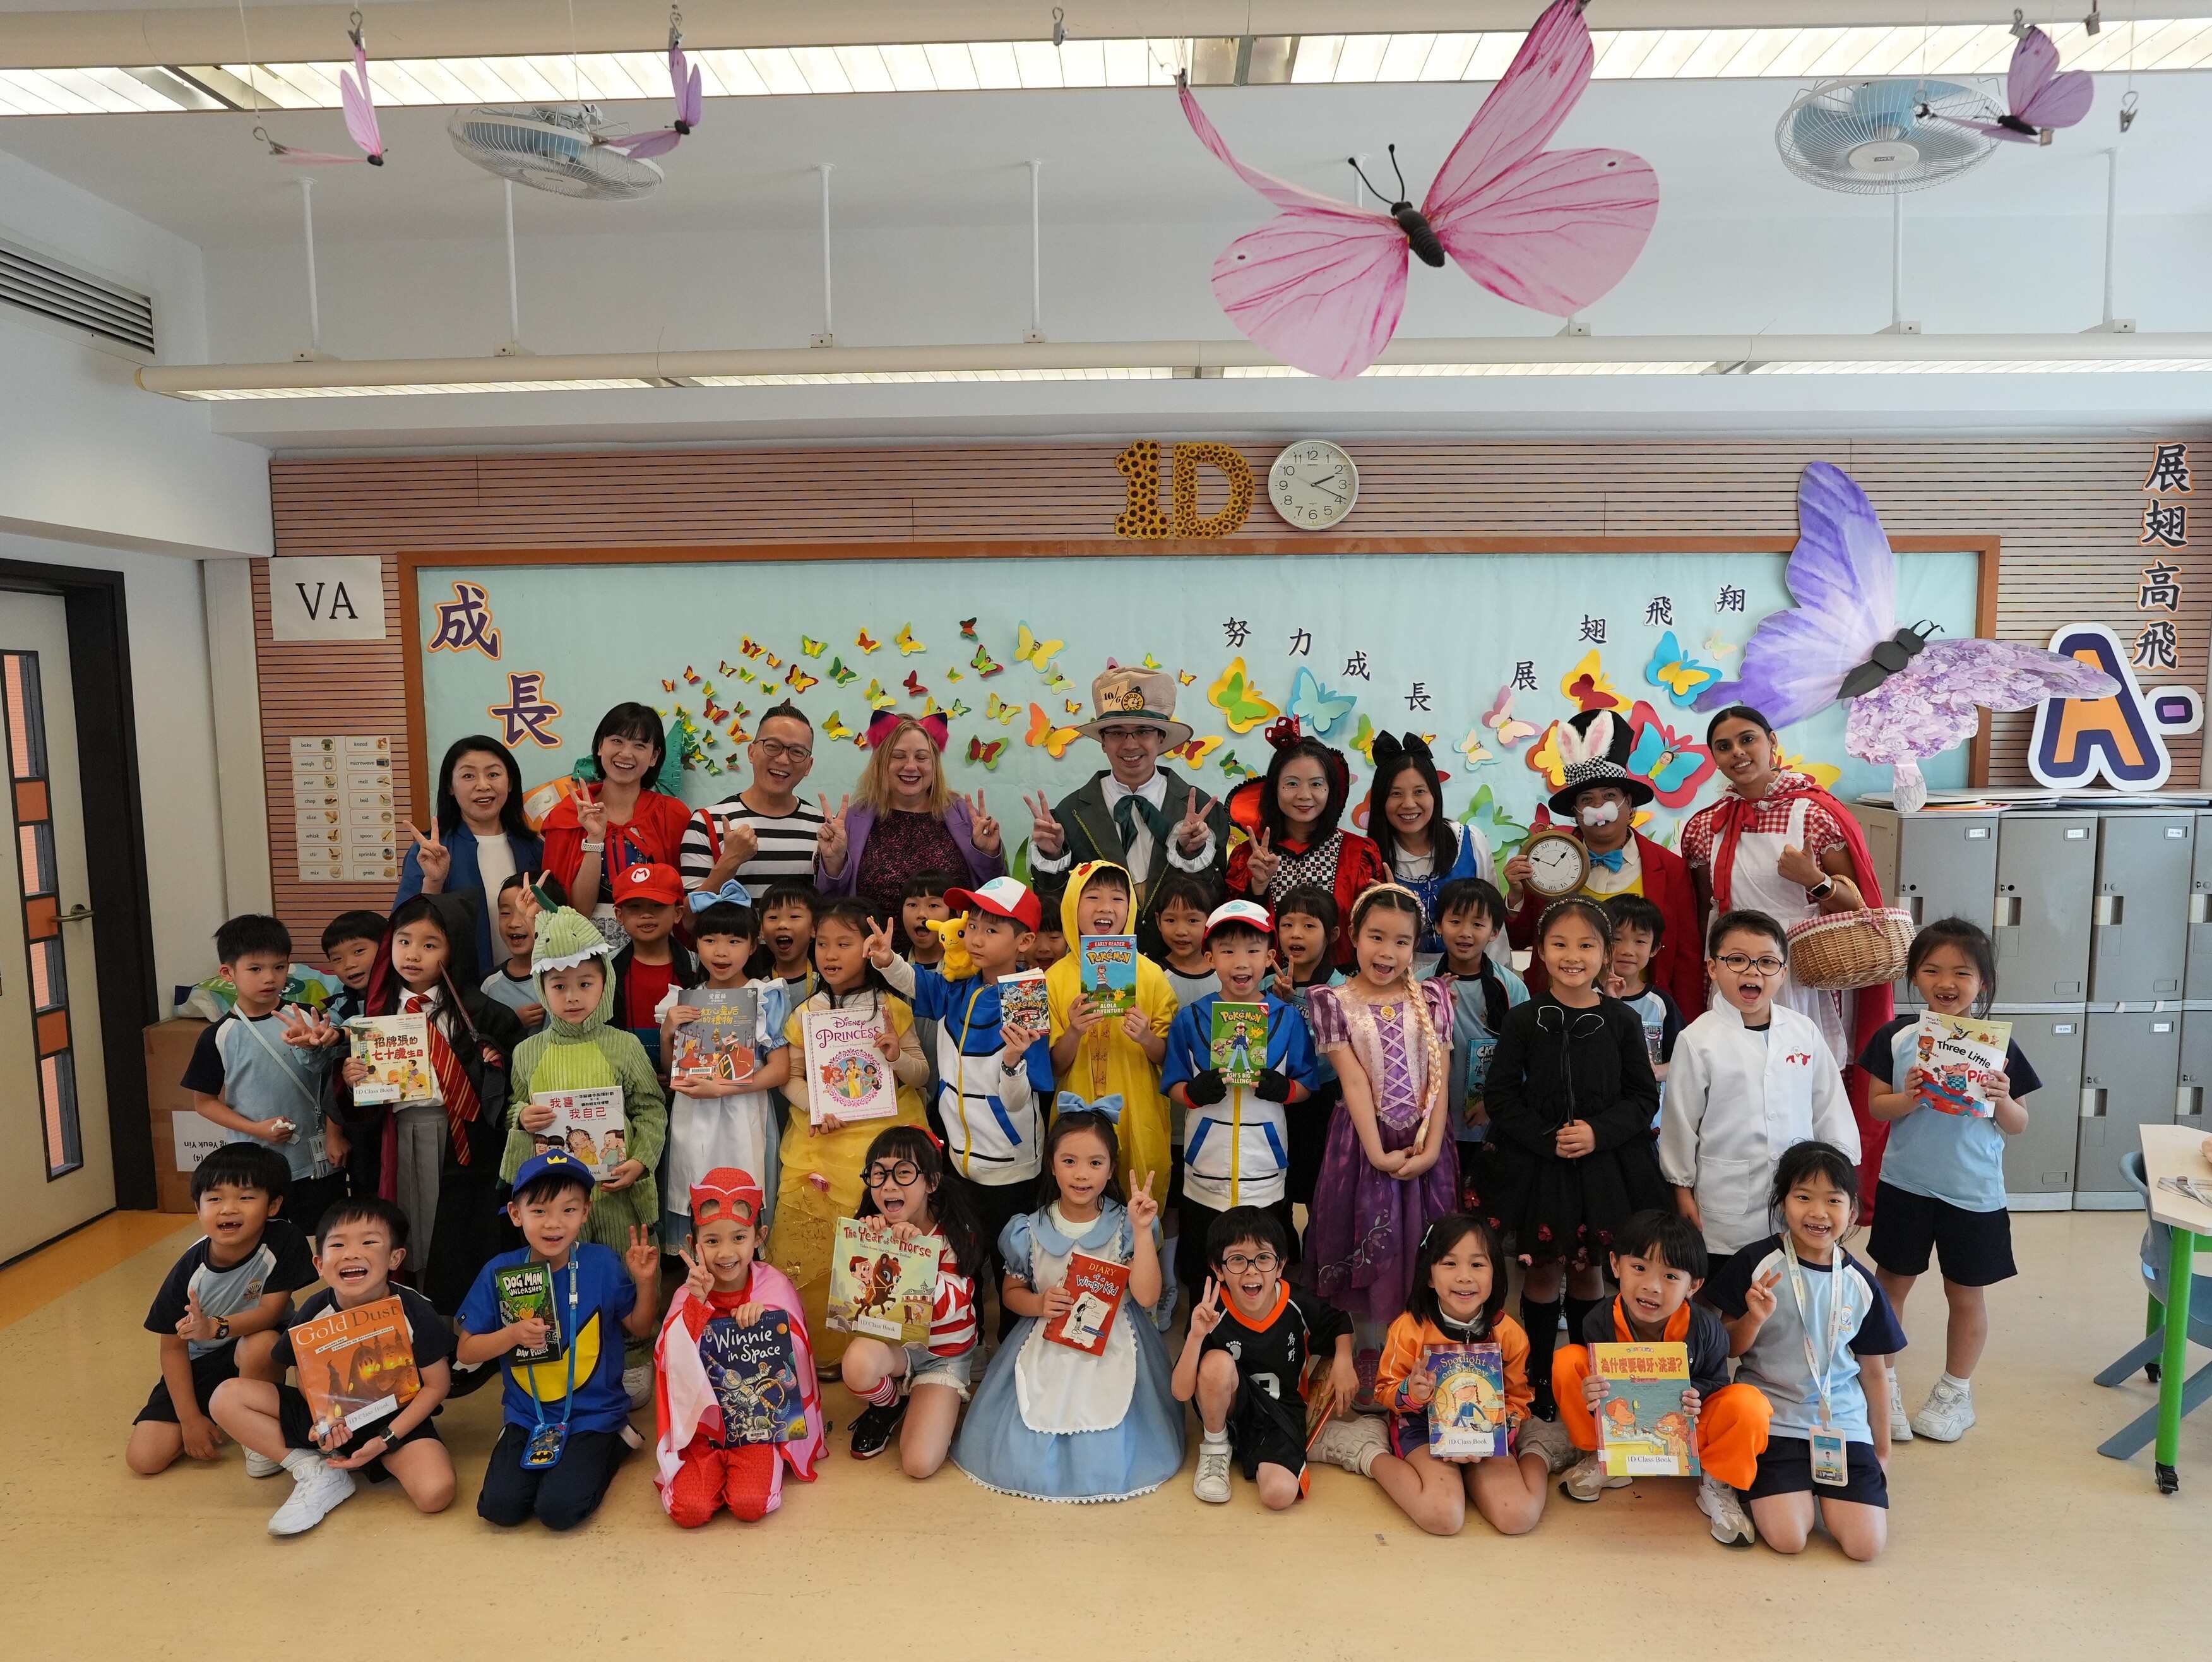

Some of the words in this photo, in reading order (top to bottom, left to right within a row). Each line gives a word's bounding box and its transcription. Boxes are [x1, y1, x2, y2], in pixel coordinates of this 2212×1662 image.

[1294, 454, 1302, 464] 11
[1307, 450, 1318, 460] 12
[1326, 454, 1329, 463] 1
[1283, 465, 1295, 476] 10
[1335, 464, 1343, 475] 2
[1114, 439, 1255, 539] 1D
[1279, 480, 1288, 491] 9
[1338, 479, 1347, 490] 3
[1284, 495, 1293, 505] 8
[1335, 495, 1343, 505] 4
[1295, 506, 1303, 517] 7
[1309, 510, 1317, 520] 6
[1324, 506, 1333, 515] 5
[2134, 443, 2191, 669] 展翅高飛
[295, 582, 359, 620] VA
[429, 581, 562, 746] 成長
[374, 1034, 418, 1049] 招牌張的
[816, 1026, 881, 1049] PRINCESS
[372, 1048, 424, 1061] 七十歲生日
[1937, 1041, 1966, 1056] Three
[1968, 1051, 1990, 1068] Little
[569, 1107, 606, 1120] 我自己
[844, 1226, 857, 1239] The
[859, 1226, 884, 1244] Year
[884, 1237, 890, 1245] of
[890, 1236, 899, 1245] the
[1088, 1263, 1117, 1276] DIARY
[502, 1274, 523, 1291] DOG
[524, 1272, 544, 1286] MAN
[1103, 1281, 1119, 1296] Kid
[296, 1315, 348, 1346] Gold
[351, 1305, 399, 1327] Dust
[869, 1321, 882, 1329] Class
[883, 1324, 896, 1332] Book
[713, 1325, 773, 1354] Winnie
[516, 1348, 529, 1357] DAV
[728, 1350, 739, 1363] in
[740, 1344, 780, 1365] Space
[1440, 1353, 1486, 1368] Spotlight
[1442, 1370, 1454, 1379] on
[1454, 1364, 1489, 1378] Stacey
